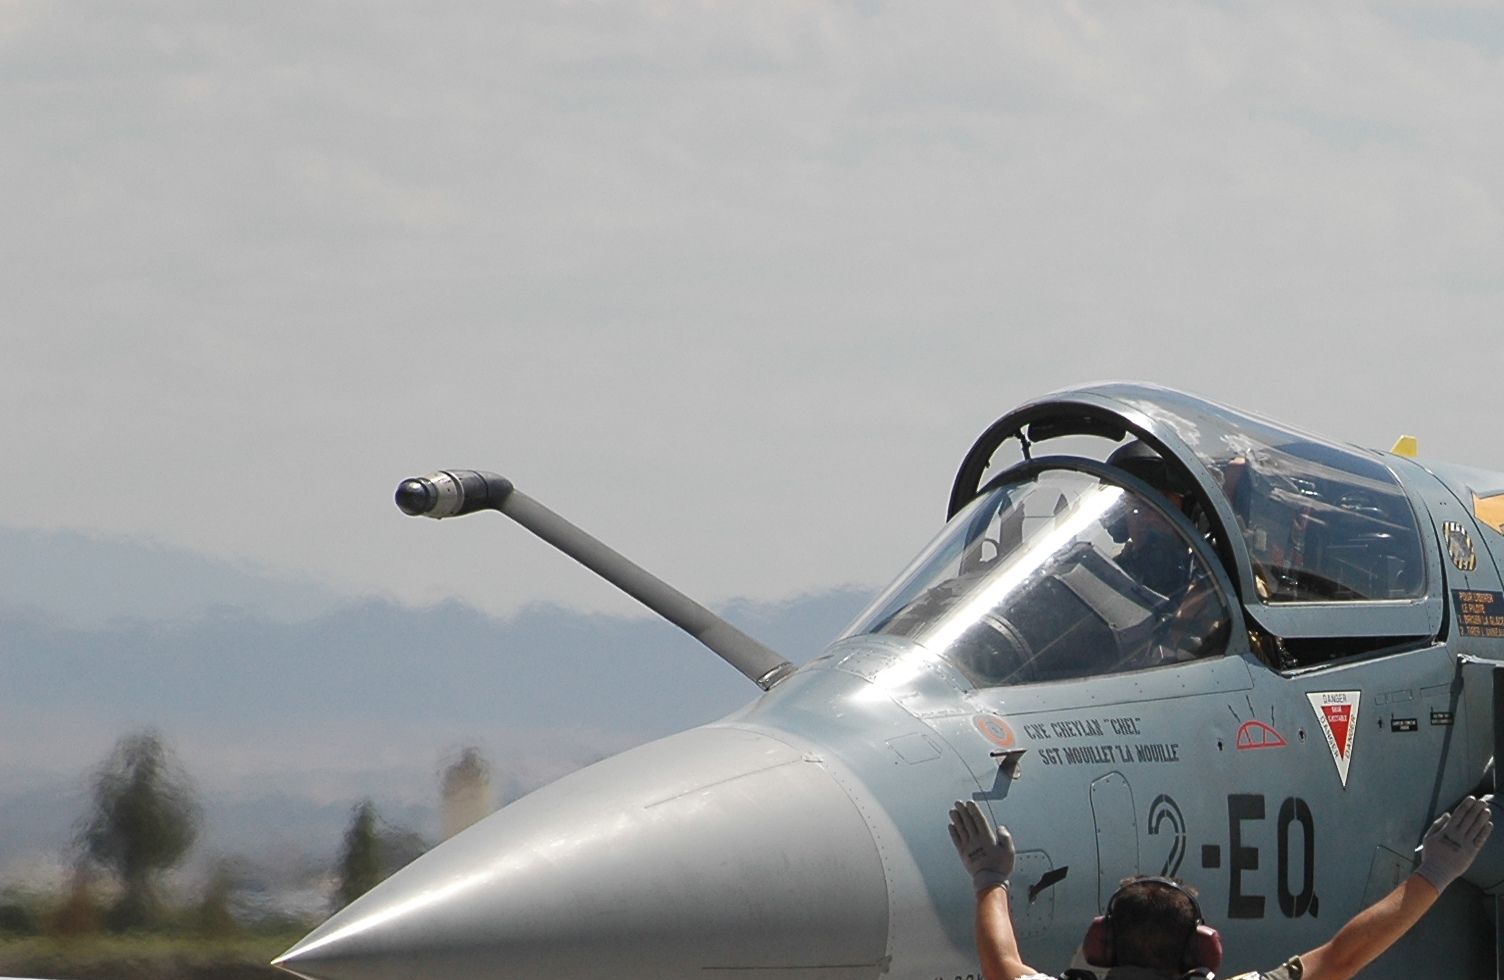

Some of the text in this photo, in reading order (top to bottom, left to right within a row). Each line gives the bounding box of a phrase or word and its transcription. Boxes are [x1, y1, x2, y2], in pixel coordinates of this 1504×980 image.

[1322, 694, 1347, 704] DANGER
[1024, 723, 1051, 740] CNE
[1038, 748, 1063, 765] SGT
